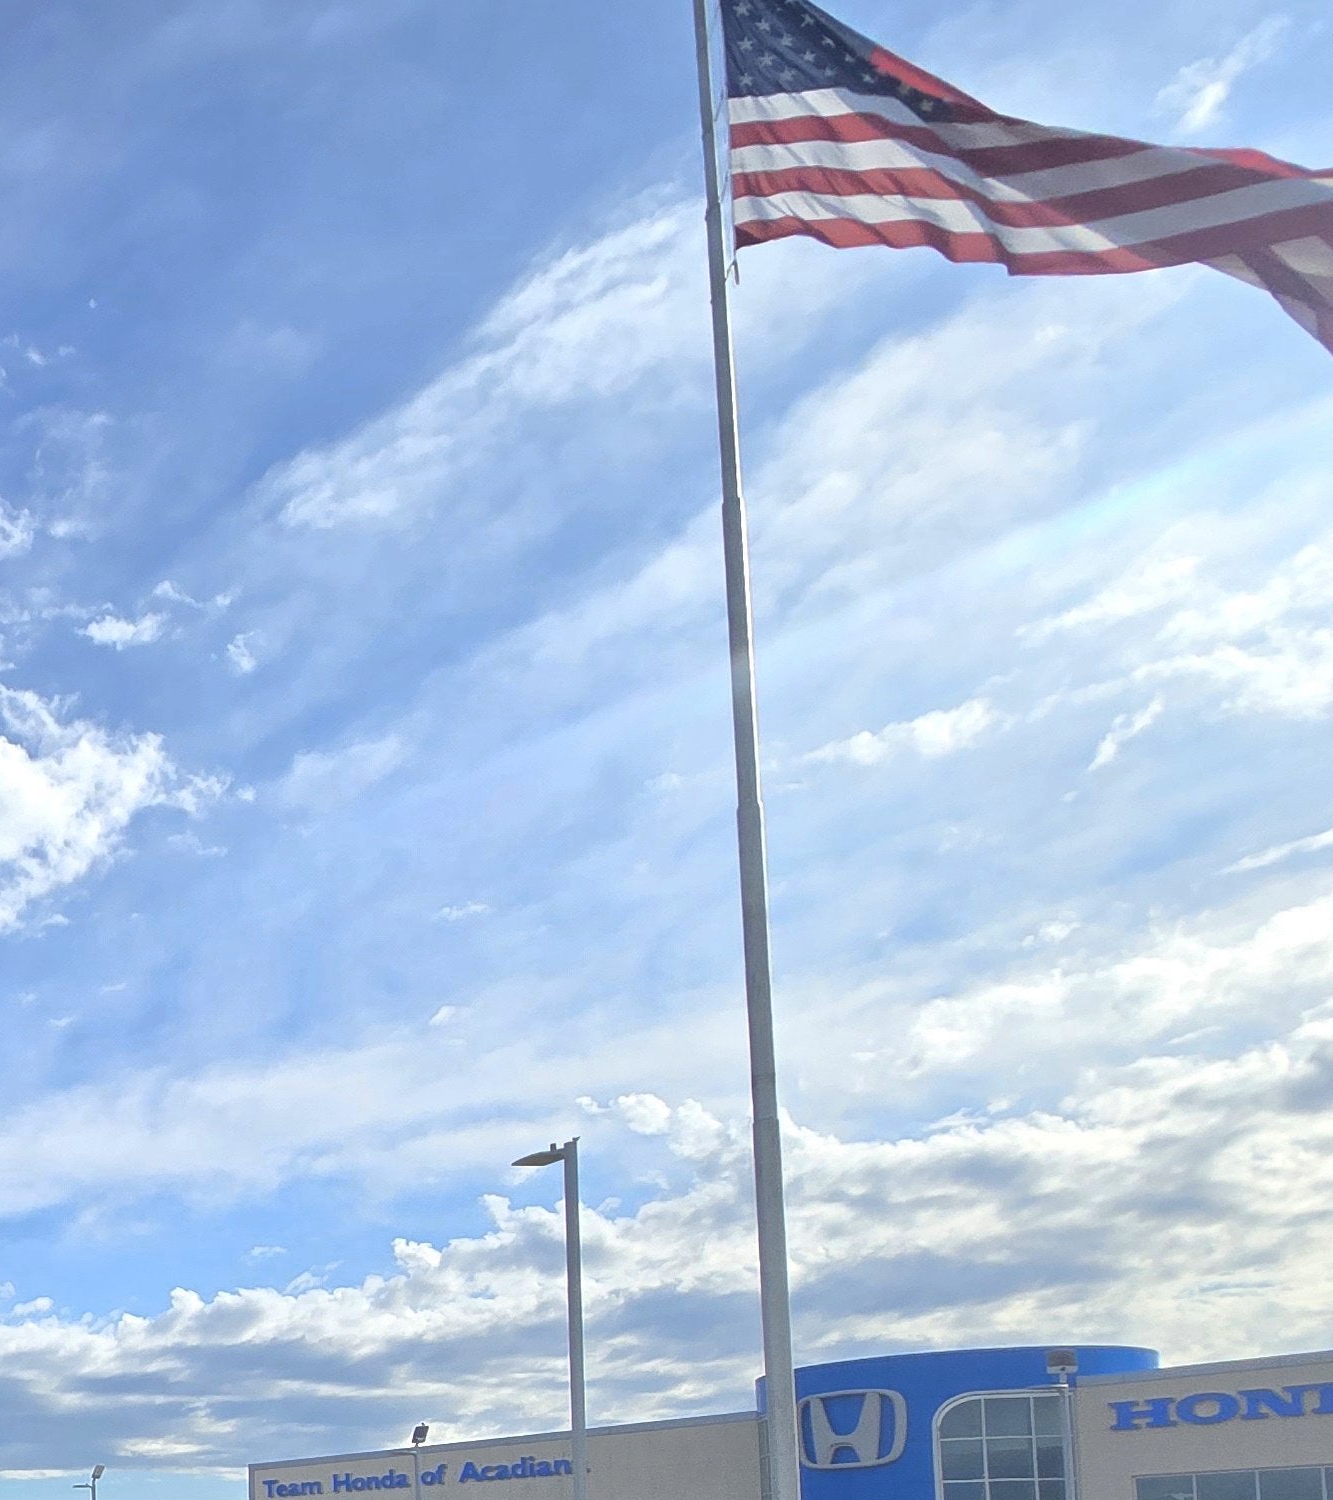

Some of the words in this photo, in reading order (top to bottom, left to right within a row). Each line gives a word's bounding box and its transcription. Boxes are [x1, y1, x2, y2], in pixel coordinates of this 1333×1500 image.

[262, 1479, 322, 1499] Team
[333, 1469, 410, 1492] Honda
[421, 1463, 448, 1486] of
[459, 1455, 592, 1484] Acadian
